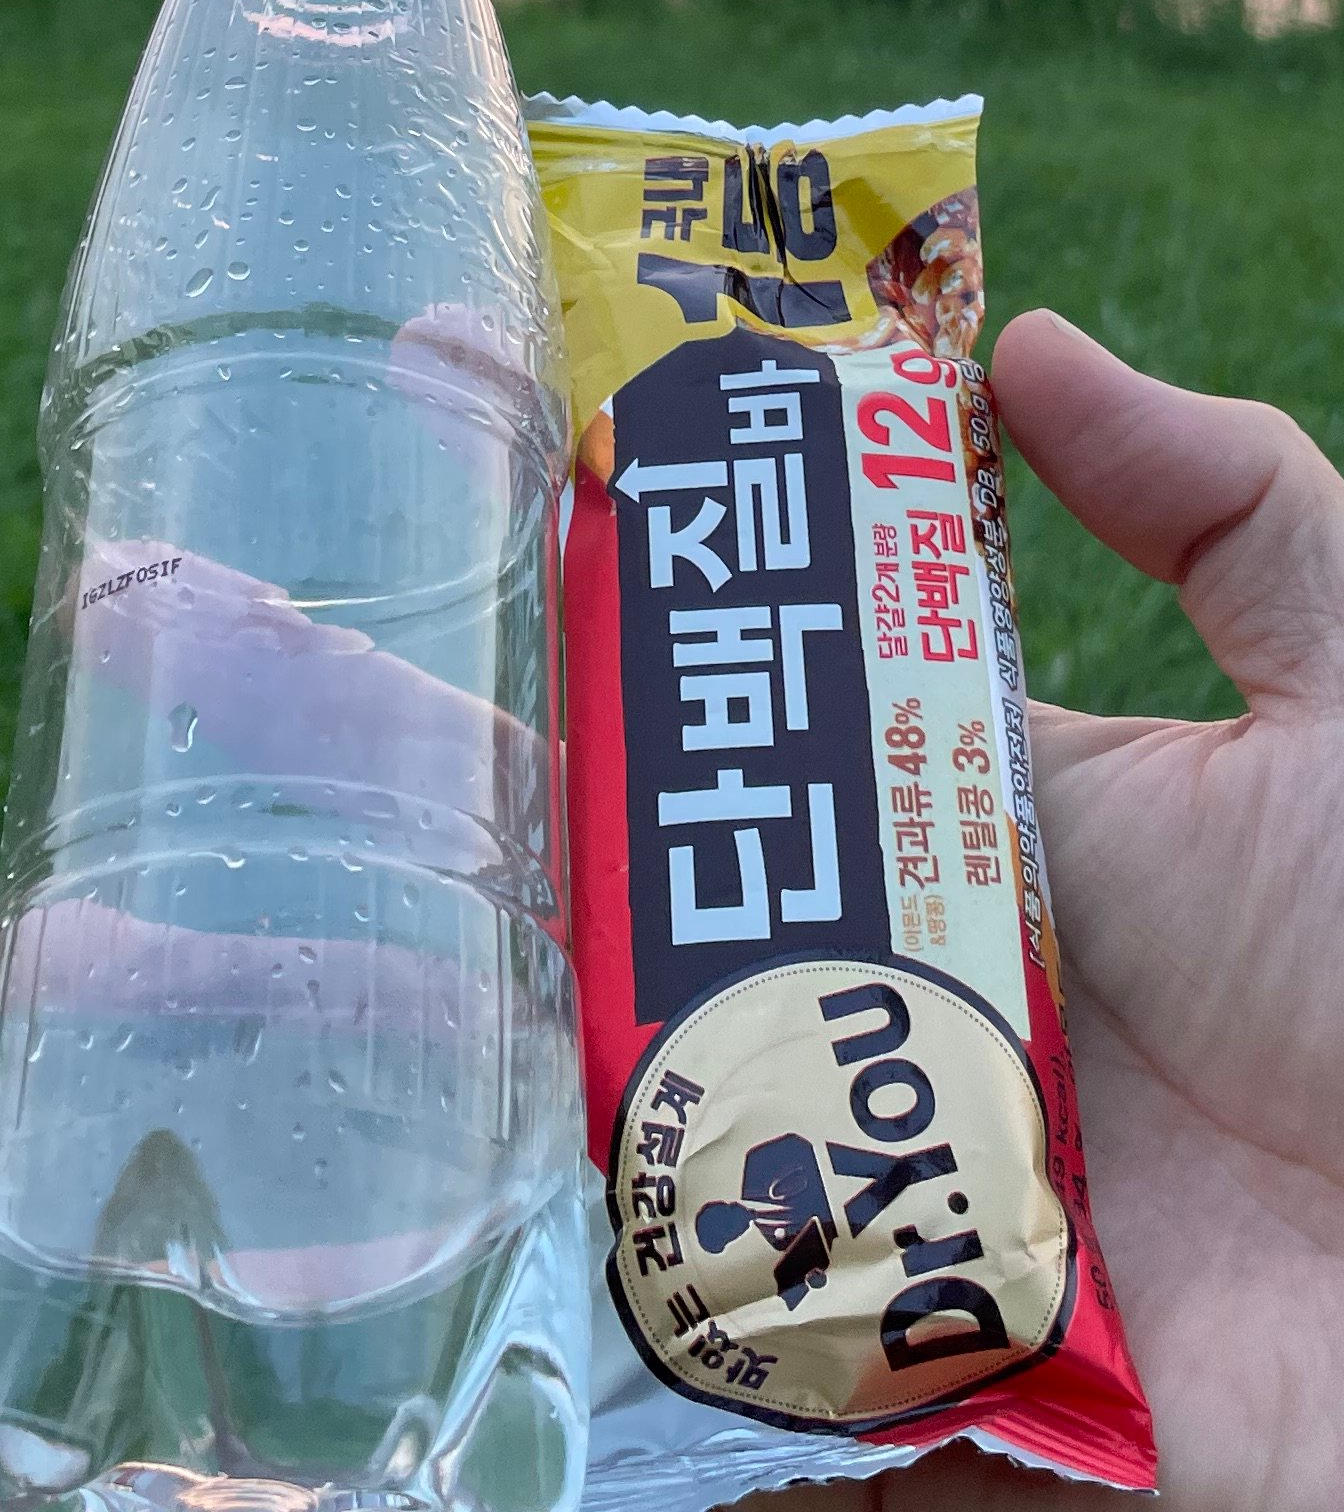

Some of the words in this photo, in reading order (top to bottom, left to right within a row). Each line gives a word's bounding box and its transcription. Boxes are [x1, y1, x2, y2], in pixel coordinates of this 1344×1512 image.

[871, 522, 898, 558] 분량
[906, 509, 979, 663] 단백질
[884, 696, 928, 779] 48%
[952, 719, 992, 775] 3%
[889, 782, 941, 891] 견과류
[956, 783, 1002, 887] 렌틸콩
[632, 1070, 706, 1278] 건강설계
[666, 1284, 778, 1389] 맛있는
